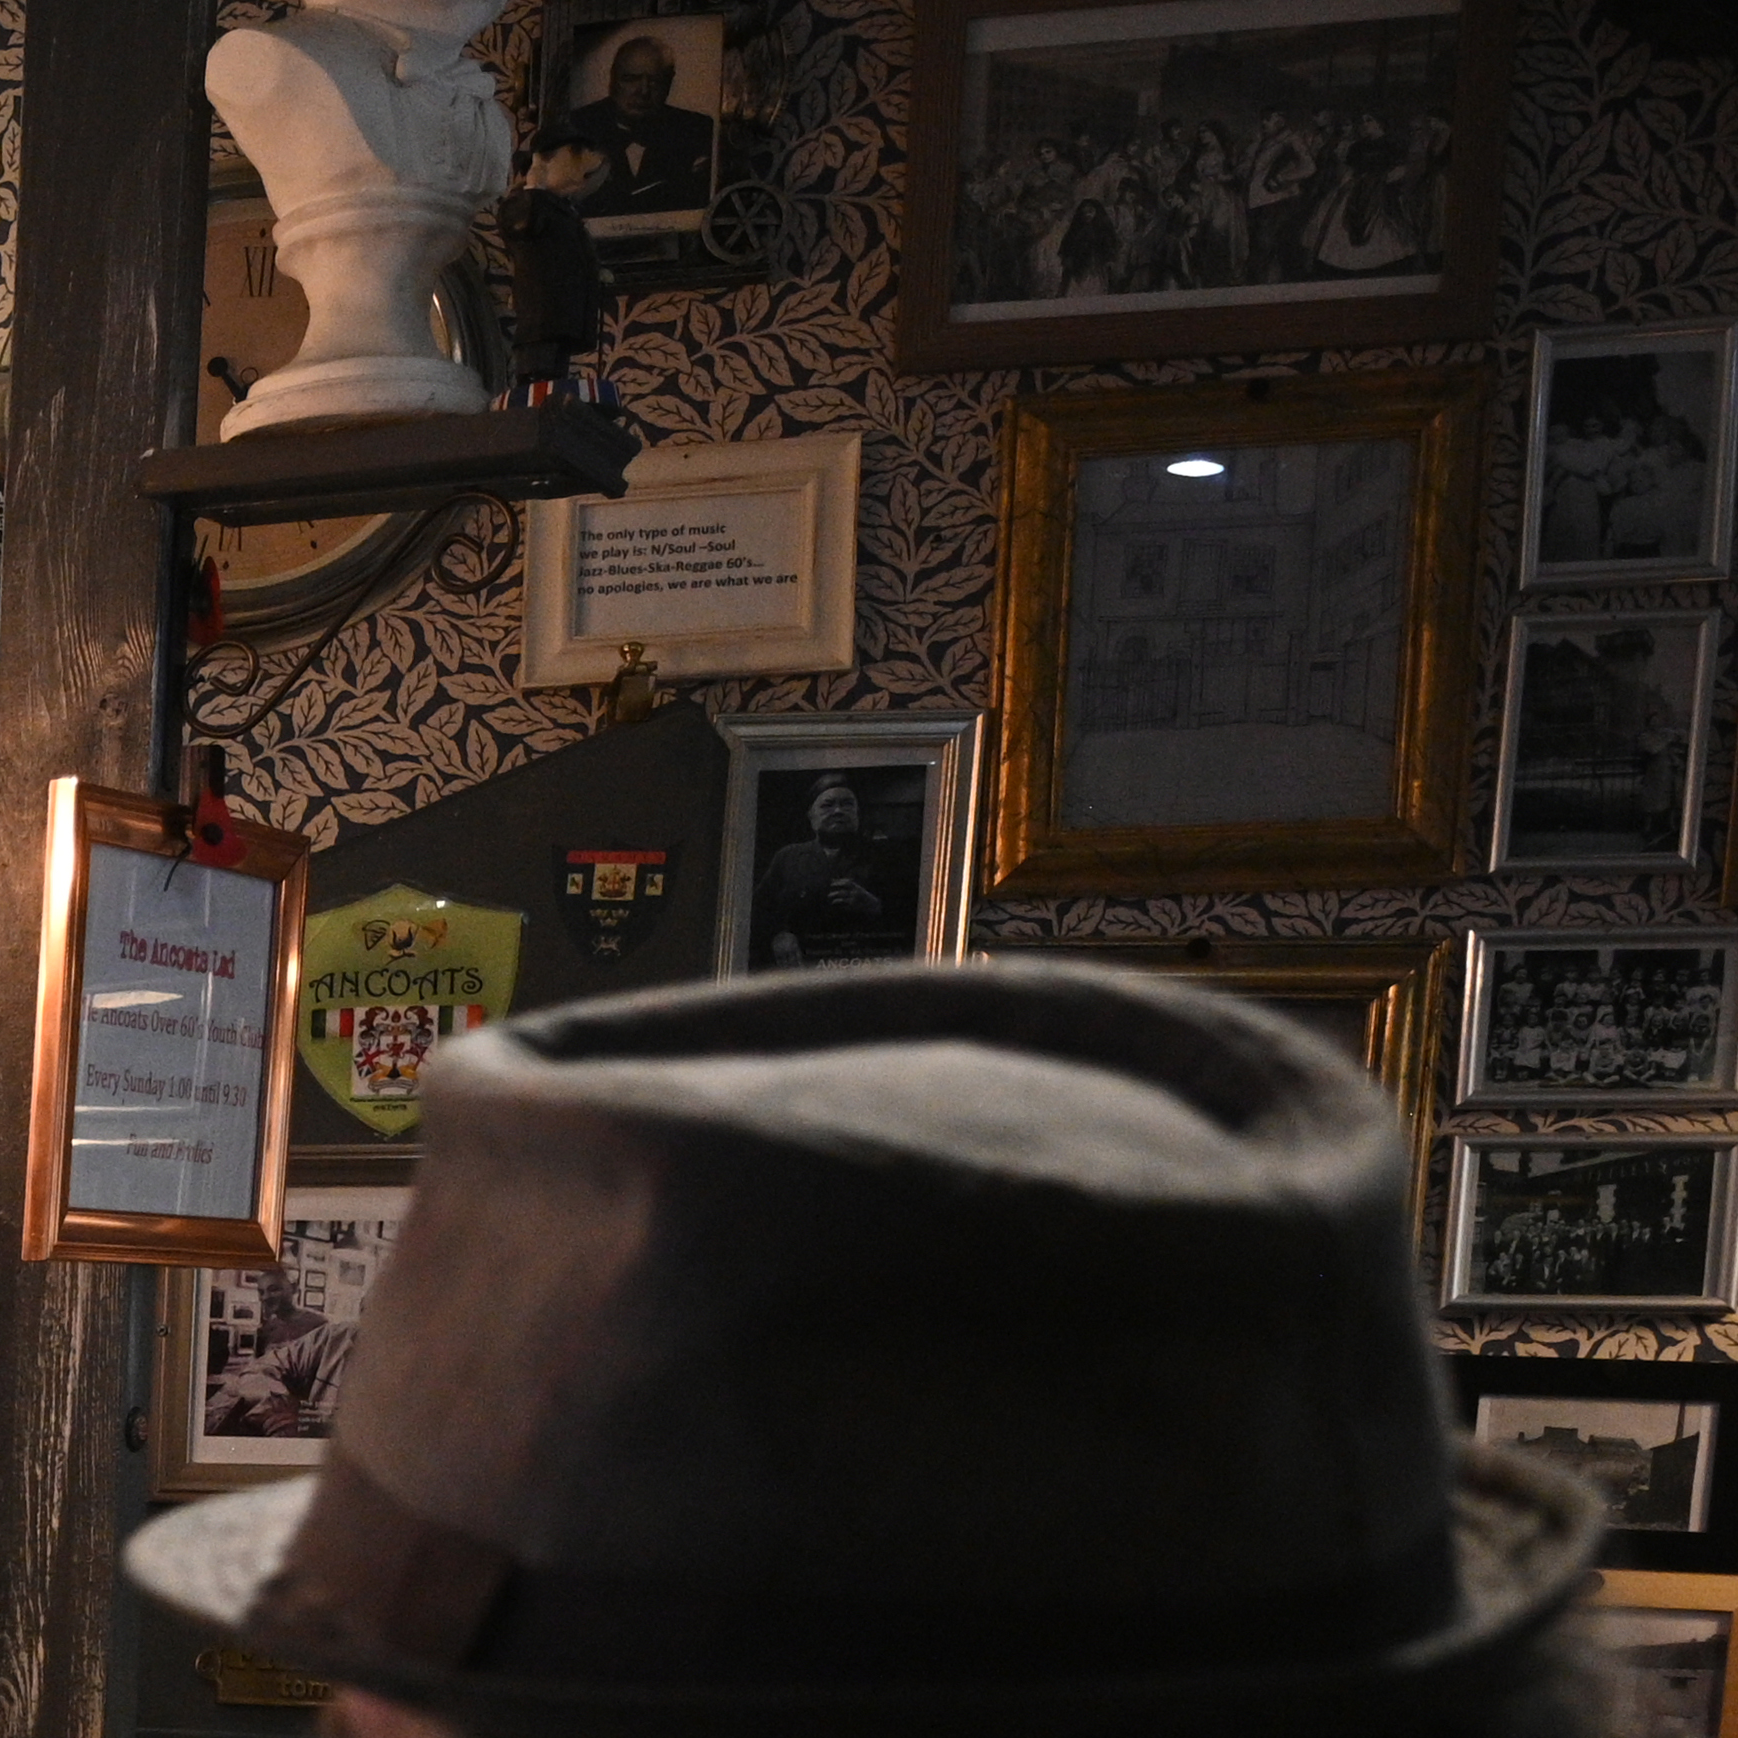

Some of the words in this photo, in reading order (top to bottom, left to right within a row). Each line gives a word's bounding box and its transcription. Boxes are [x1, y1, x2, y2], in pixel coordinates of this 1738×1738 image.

[581, 530, 603, 541] The
[607, 528, 635, 542] only
[639, 527, 668, 540] type
[671, 525, 685, 536] of
[688, 523, 727, 535] music
[579, 550, 598, 560] we
[602, 546, 628, 560] play
[577, 585, 595, 596] no
[597, 581, 664, 596] apologies,
[668, 581, 687, 590] we
[691, 579, 712, 589] are
[716, 576, 749, 587] what
[753, 576, 773, 585] we
[776, 574, 798, 584] are
[119, 930, 147, 963] The
[150, 938, 209, 974] Ancoats
[308, 966, 484, 1004] ANCOATS
[151, 1009, 179, 1034] Over
[86, 1063, 120, 1096] Every
[123, 1069, 166, 1103] Sunday
[169, 1074, 193, 1099] 1.00
[195, 1080, 222, 1105] until
[223, 1084, 247, 1107] 9.30
[150, 1138, 171, 1159] and
